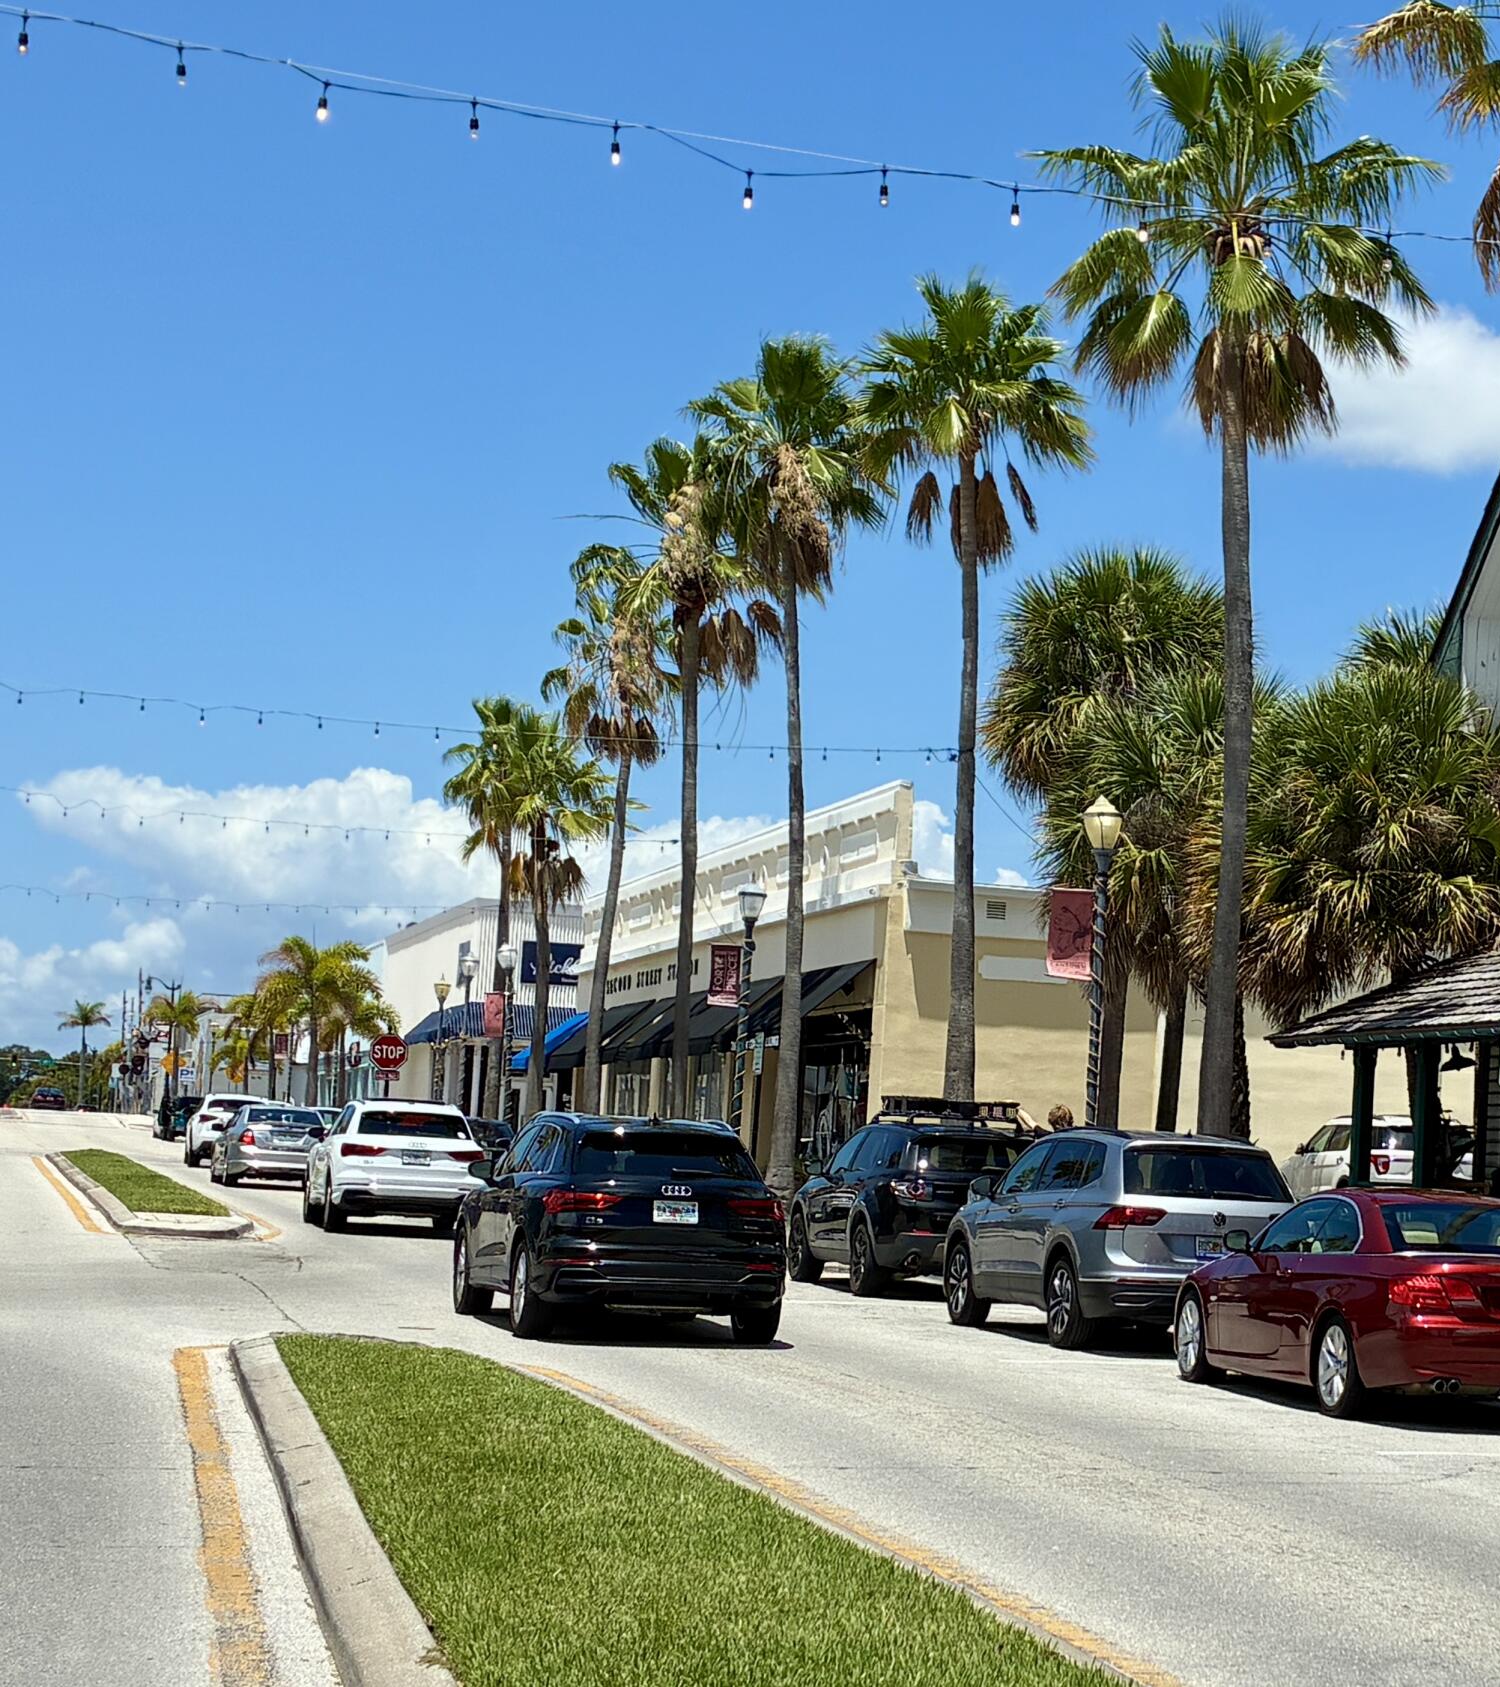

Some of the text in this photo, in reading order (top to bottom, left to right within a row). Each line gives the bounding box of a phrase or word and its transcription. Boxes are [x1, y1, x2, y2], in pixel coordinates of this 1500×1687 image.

[606, 974, 632, 995] SECOND
[636, 968, 663, 988] STREET
[725, 956, 738, 992] PIERCE
[373, 1045, 405, 1060] STOP
